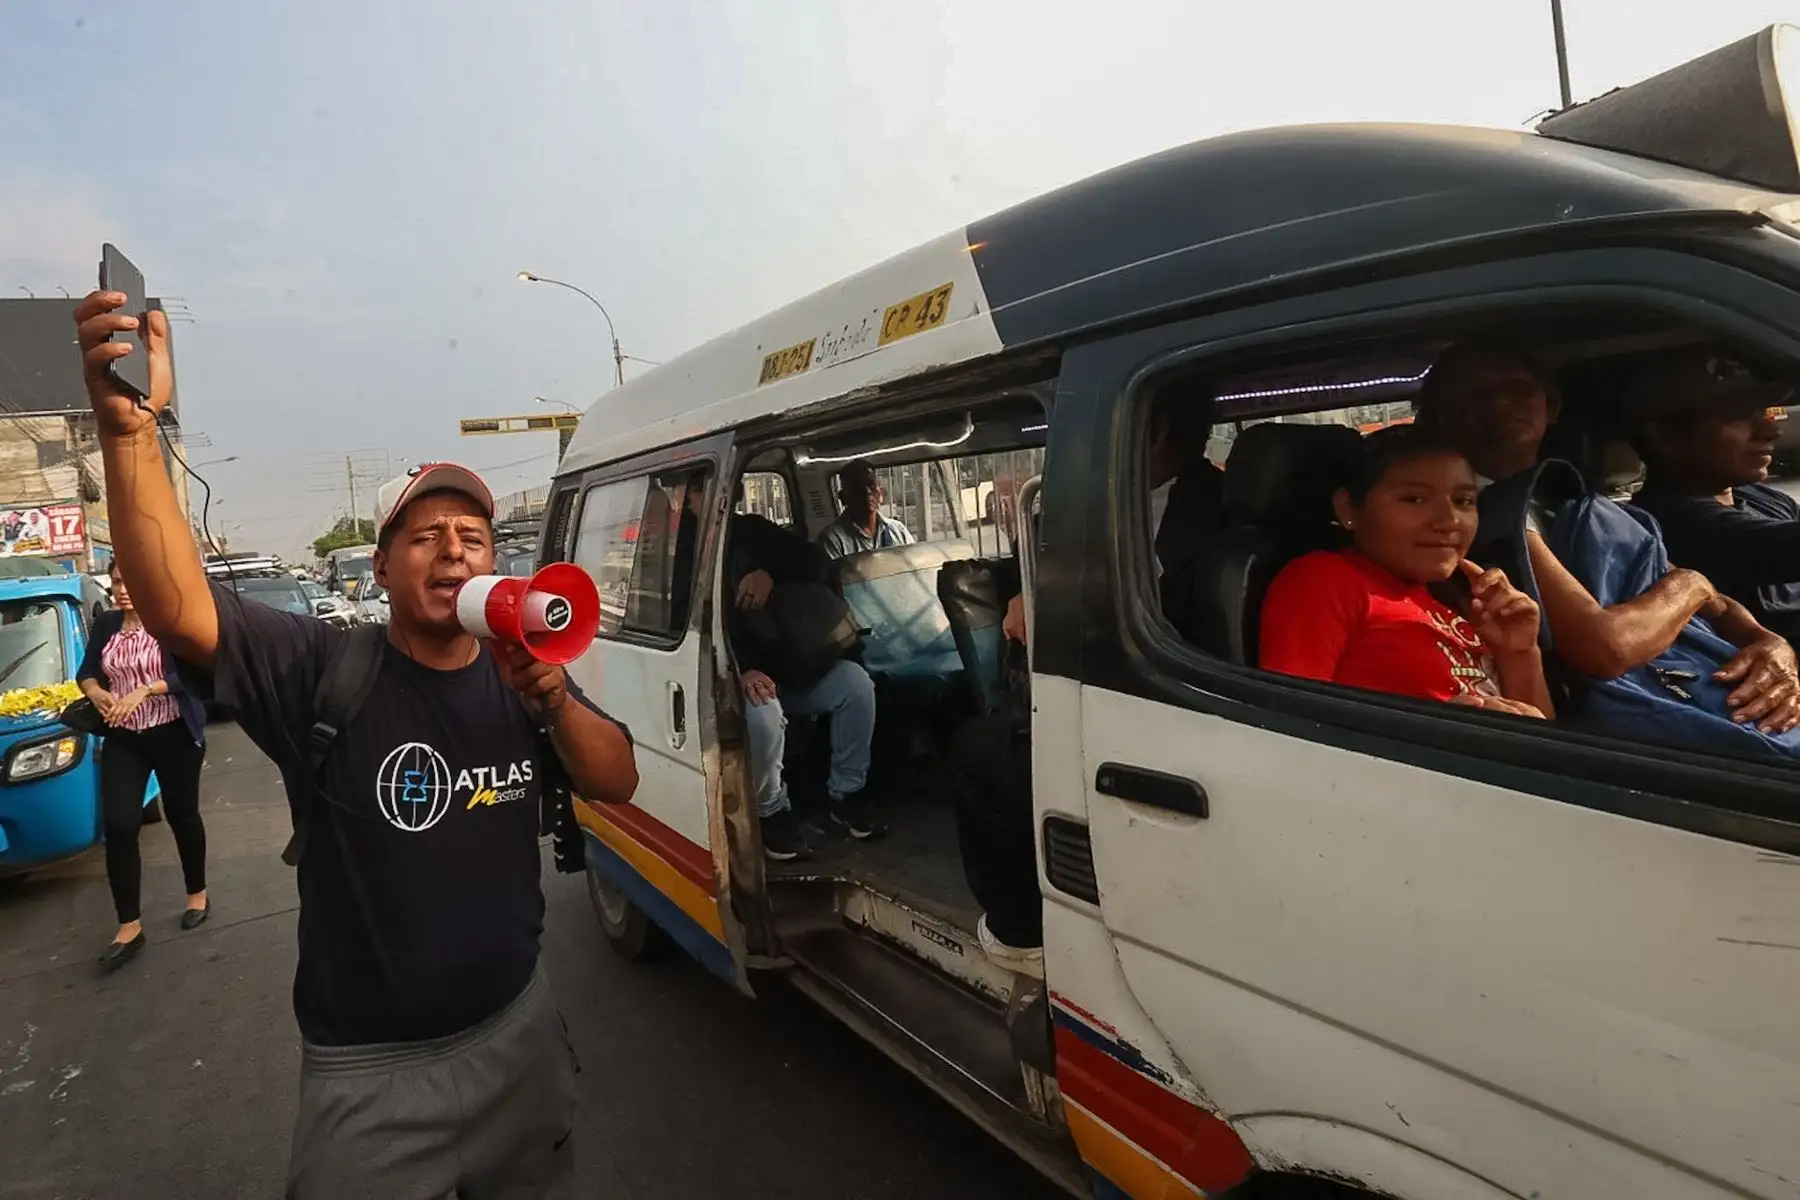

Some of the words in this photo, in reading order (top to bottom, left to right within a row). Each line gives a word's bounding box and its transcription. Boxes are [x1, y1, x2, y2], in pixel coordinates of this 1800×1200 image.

[915, 287, 951, 329] 43
[50, 515, 80, 536] 17
[454, 760, 533, 791] ATLAS
[466, 785, 526, 810] Masters
